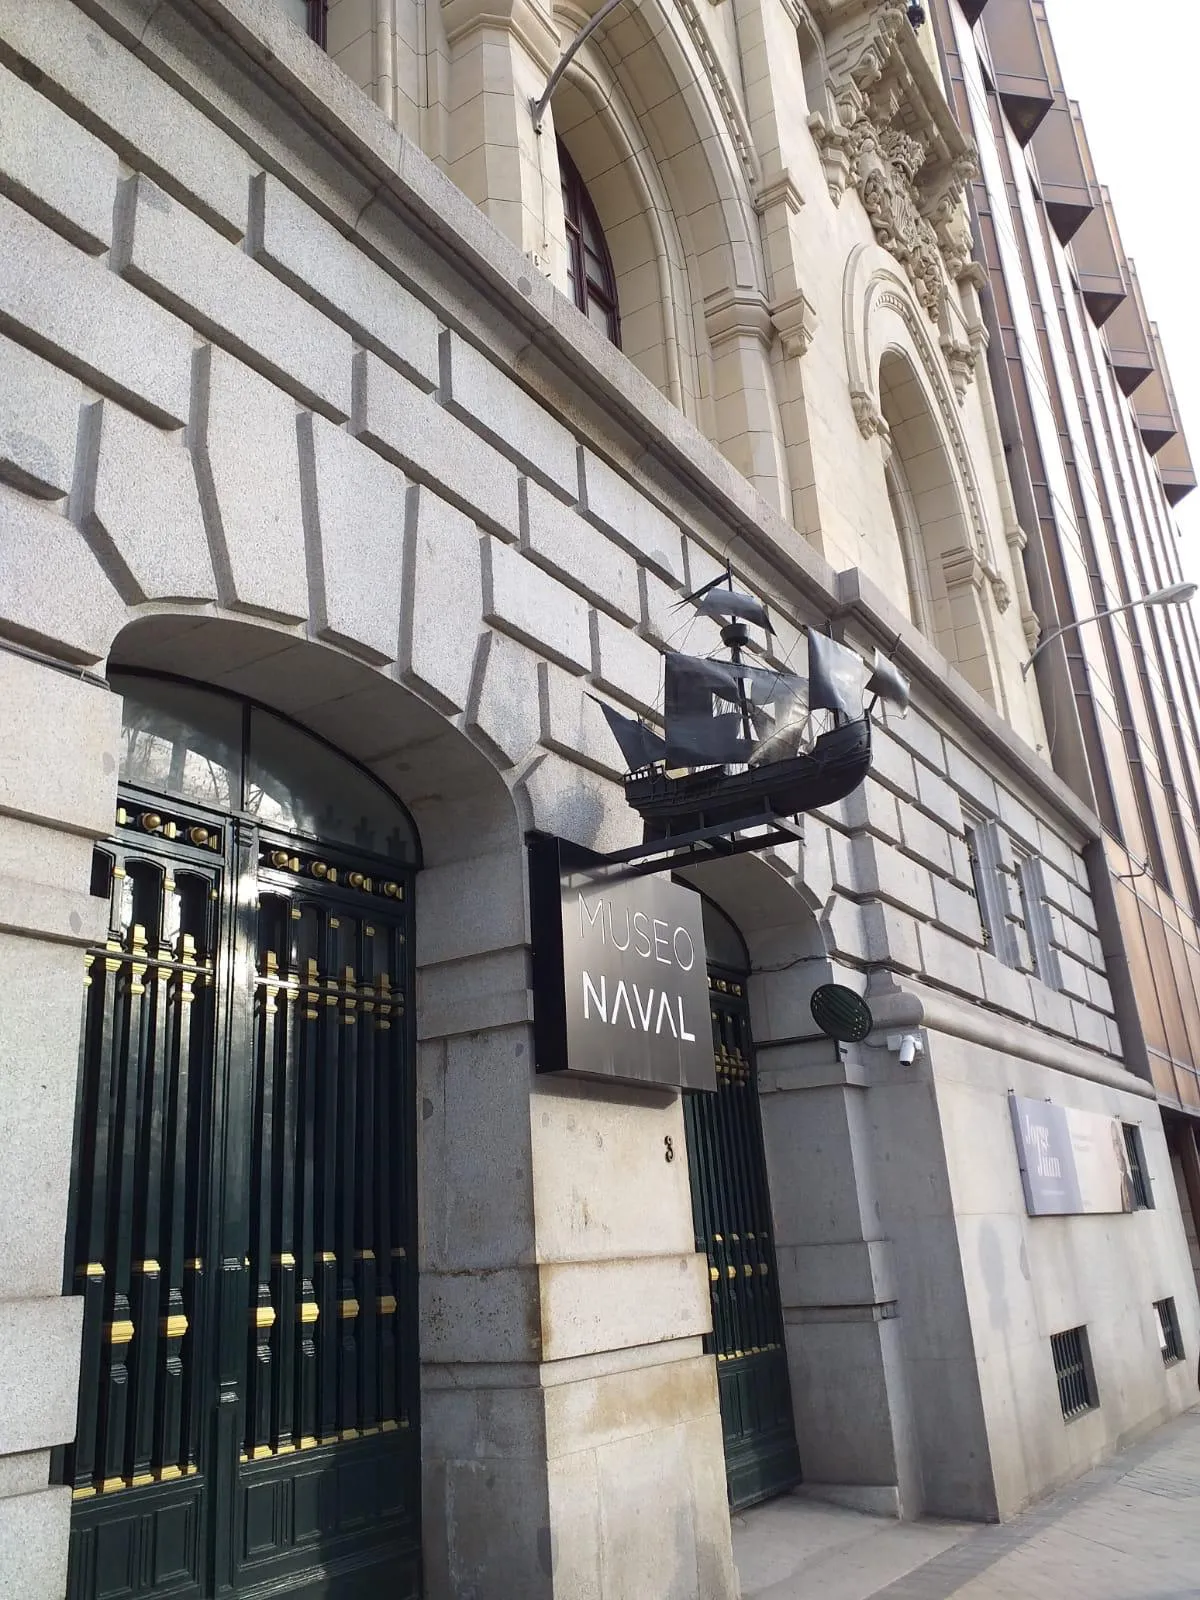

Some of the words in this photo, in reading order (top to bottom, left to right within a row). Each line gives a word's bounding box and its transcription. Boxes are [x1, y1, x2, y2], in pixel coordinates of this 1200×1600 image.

[578, 892, 694, 971] MUSEO
[582, 970, 696, 1042] NAVAL
[664, 1135, 674, 1163] 3
[1037, 1142, 1062, 1178] Juan
